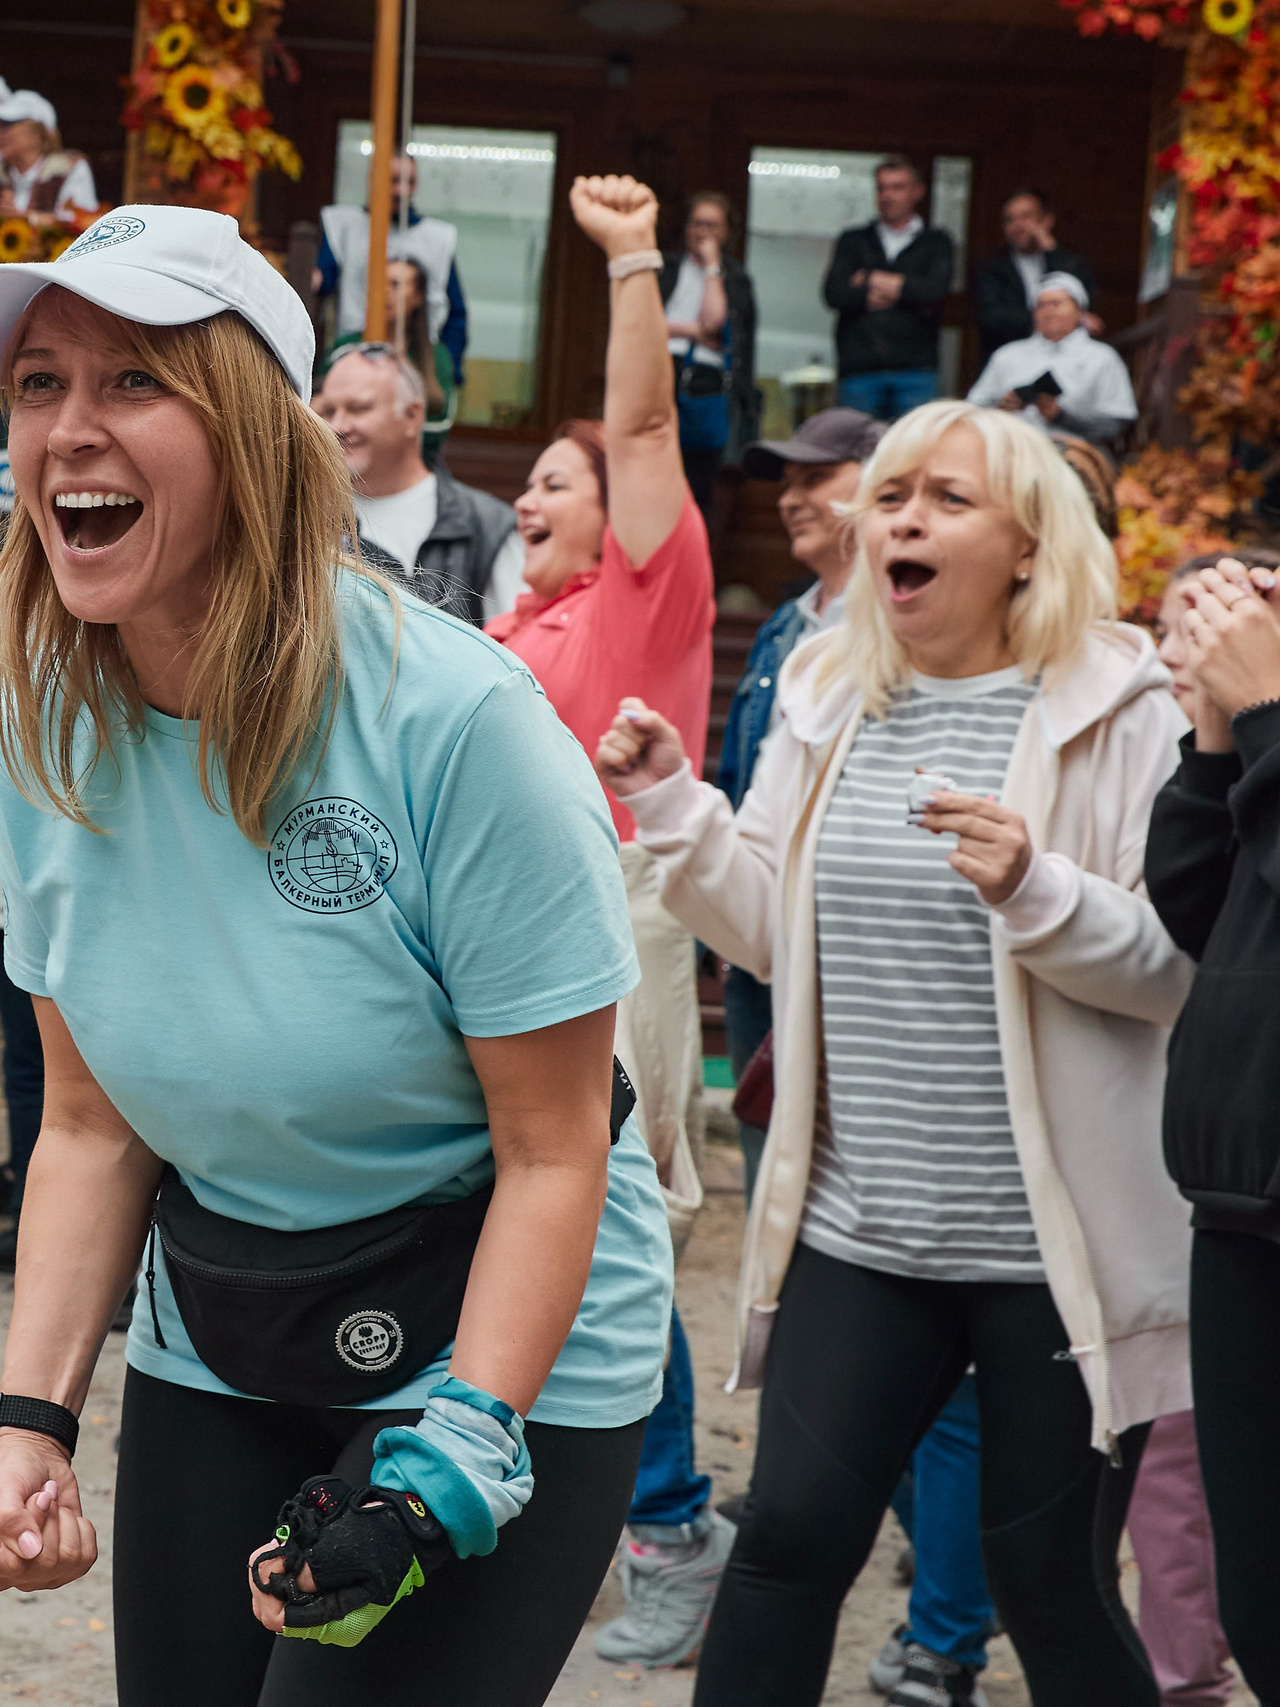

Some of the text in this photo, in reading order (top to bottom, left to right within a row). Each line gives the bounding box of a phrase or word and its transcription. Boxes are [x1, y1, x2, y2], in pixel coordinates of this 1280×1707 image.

[284, 803, 380, 836] МУРМАНСКИЙ
[274, 855, 390, 908] БАЛКЕРНЫЙ ТЕРМИНАЛ
[352, 1333, 386, 1349] CROPP
